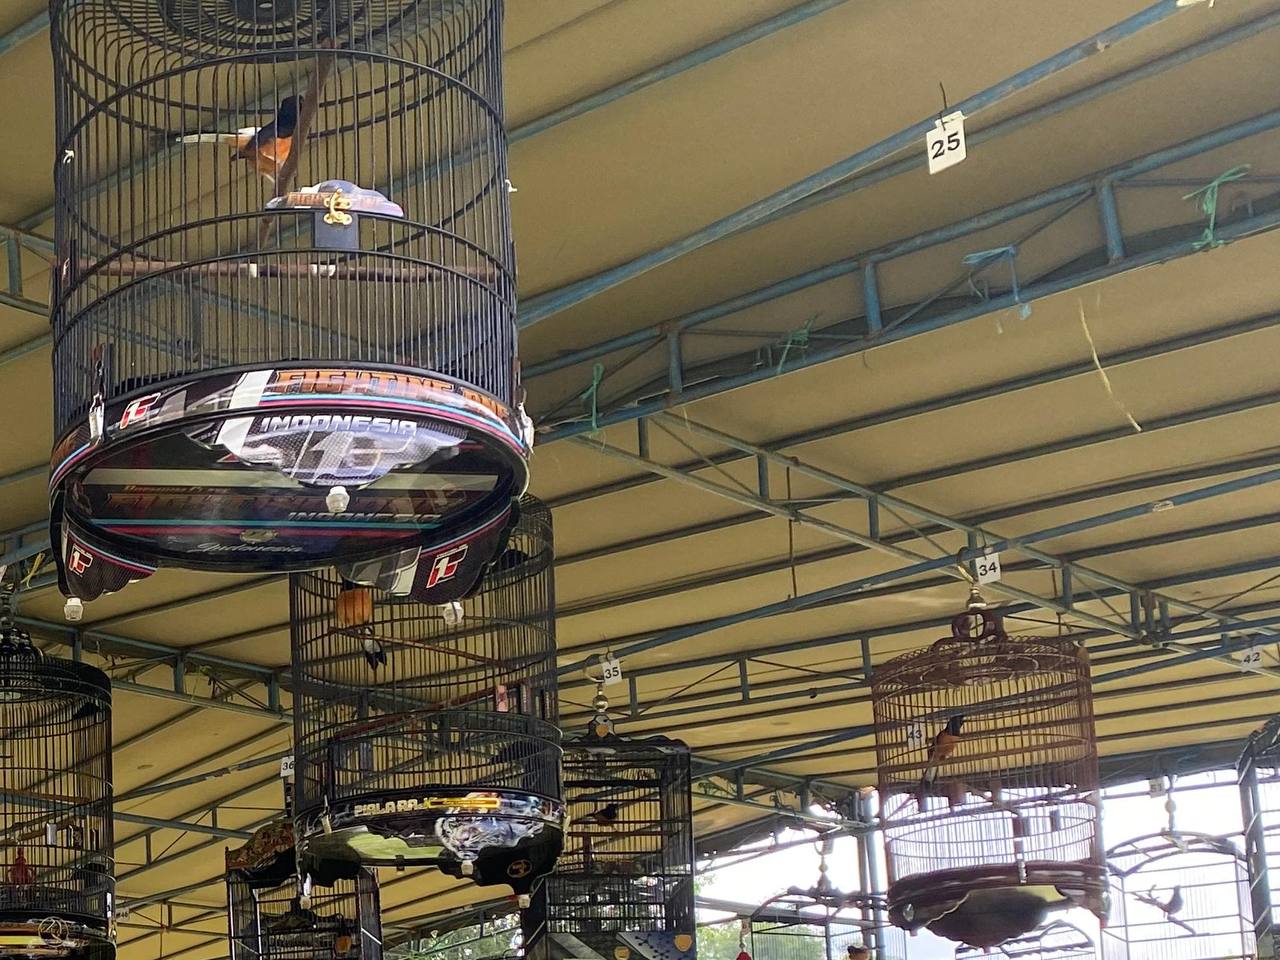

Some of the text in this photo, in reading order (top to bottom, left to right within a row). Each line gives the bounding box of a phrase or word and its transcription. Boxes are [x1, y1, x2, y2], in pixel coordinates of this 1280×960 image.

[931, 131, 960, 160] 25
[261, 414, 418, 436] INDONESIA
[979, 562, 998, 577] 34
[1243, 652, 1261, 664] 42
[604, 666, 619, 679] 35
[908, 729, 923, 740] 43
[282, 761, 295, 771] 36
[354, 801, 396, 817] PIALA
